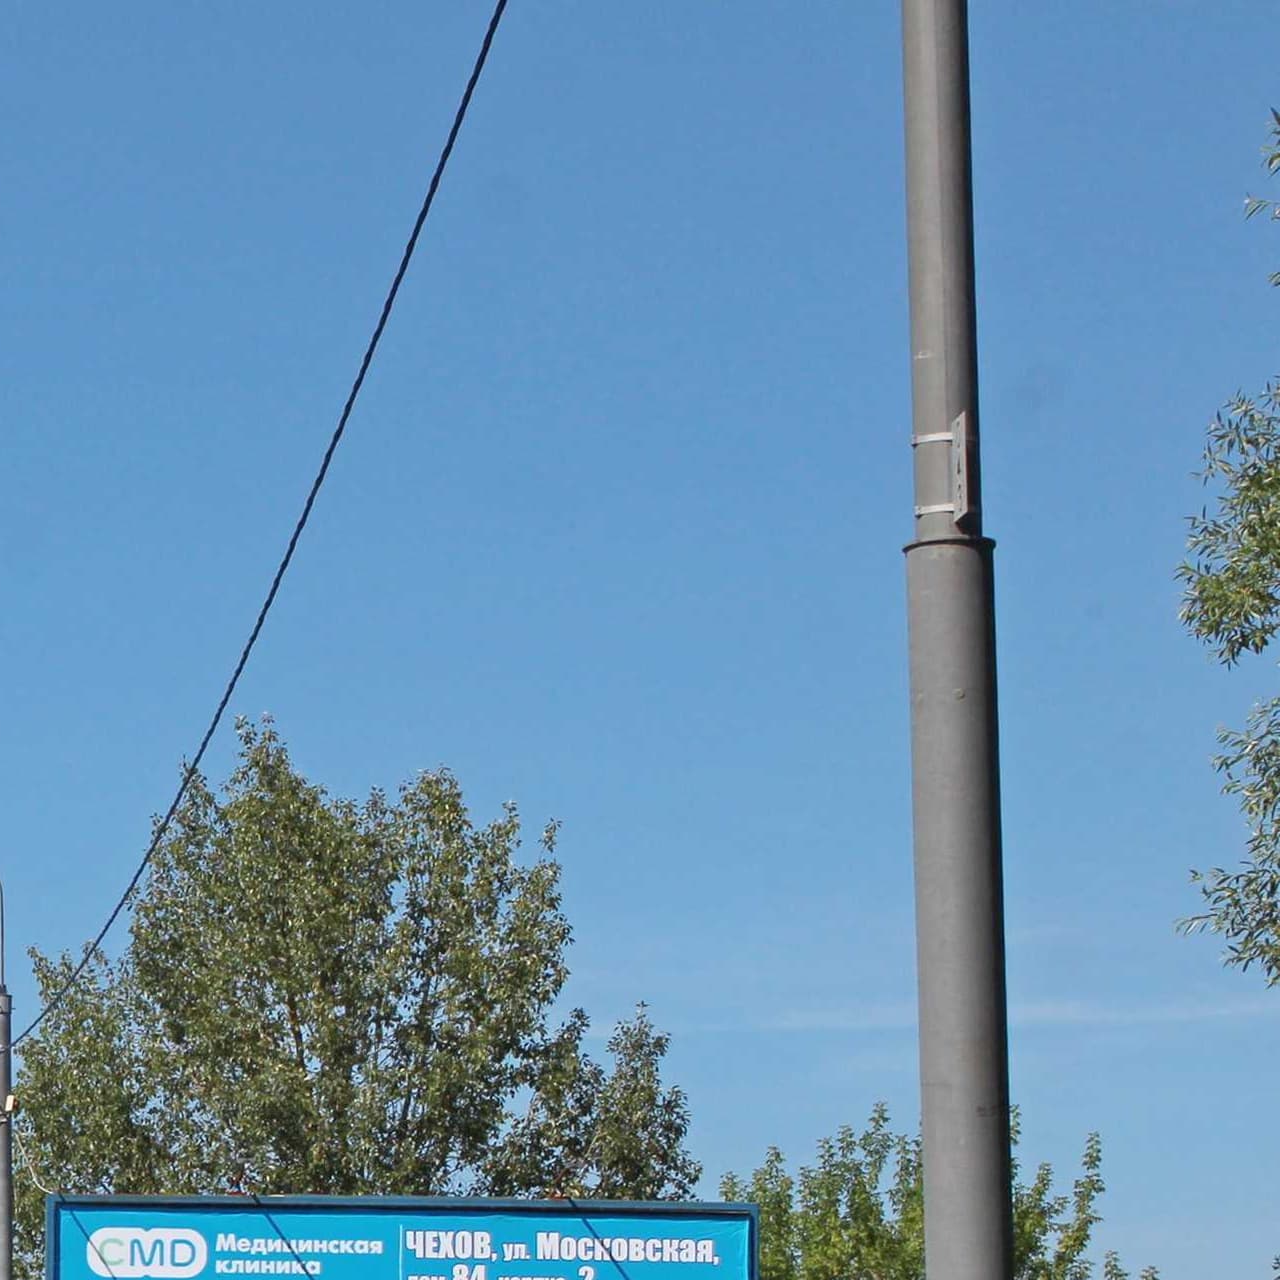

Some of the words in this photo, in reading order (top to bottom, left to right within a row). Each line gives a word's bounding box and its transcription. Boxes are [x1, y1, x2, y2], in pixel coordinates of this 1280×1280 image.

[99, 1238, 197, 1267] CMD
[215, 1233, 383, 1255] Медицинская
[405, 1230, 497, 1262] ЧЕХОВ,
[502, 1241, 530, 1261] ул.
[536, 1232, 720, 1266] Московская,
[215, 1259, 321, 1275] клиника
